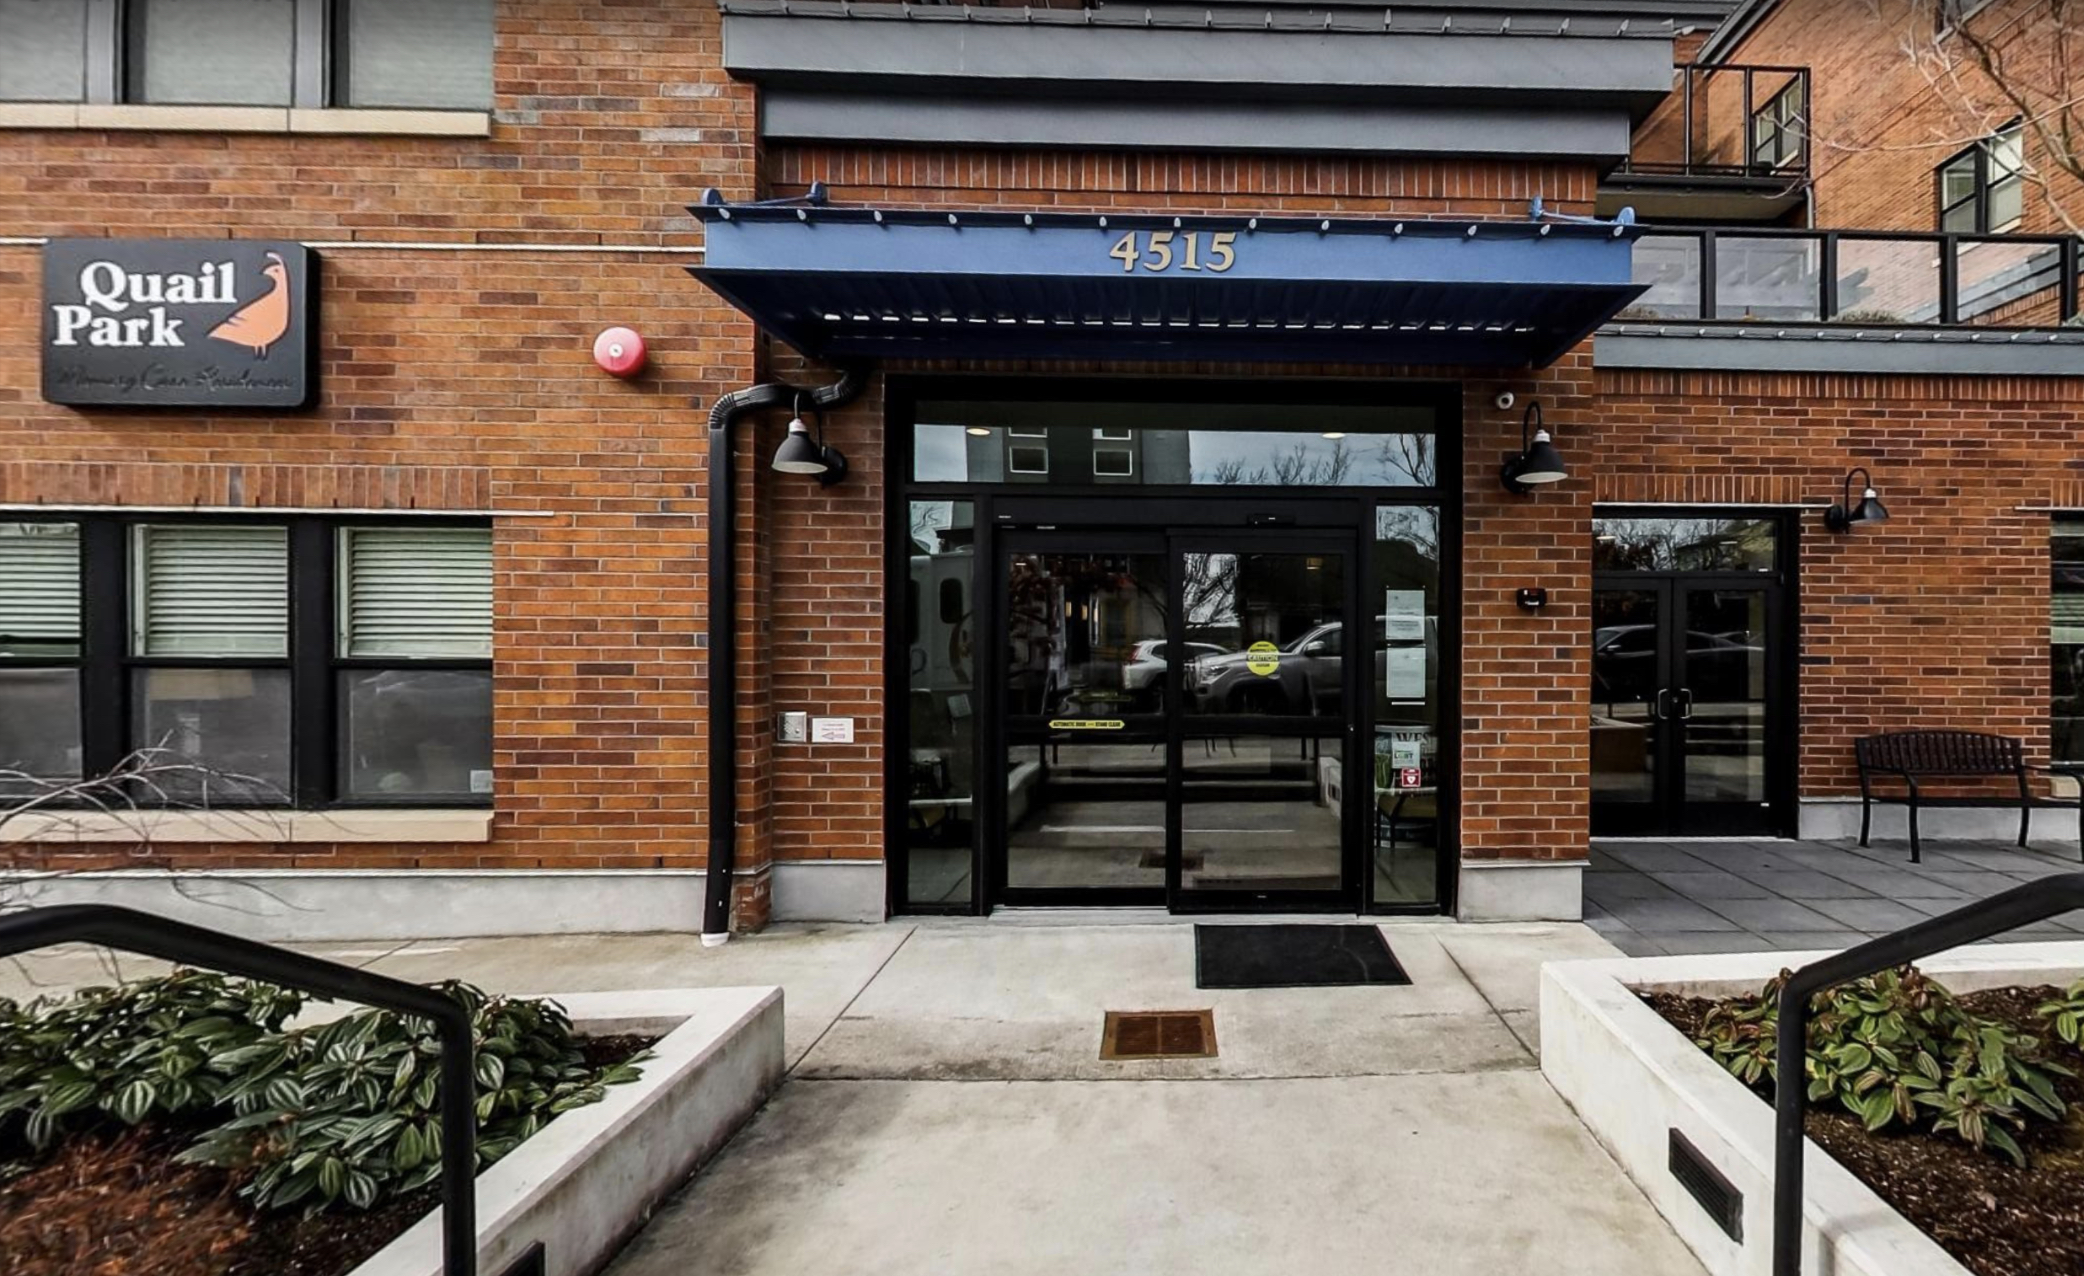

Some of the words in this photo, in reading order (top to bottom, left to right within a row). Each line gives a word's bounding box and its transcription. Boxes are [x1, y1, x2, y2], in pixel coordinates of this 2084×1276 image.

[1109, 231, 1237, 272] 4515
[80, 261, 238, 312] Quail
[52, 304, 185, 346] Park
